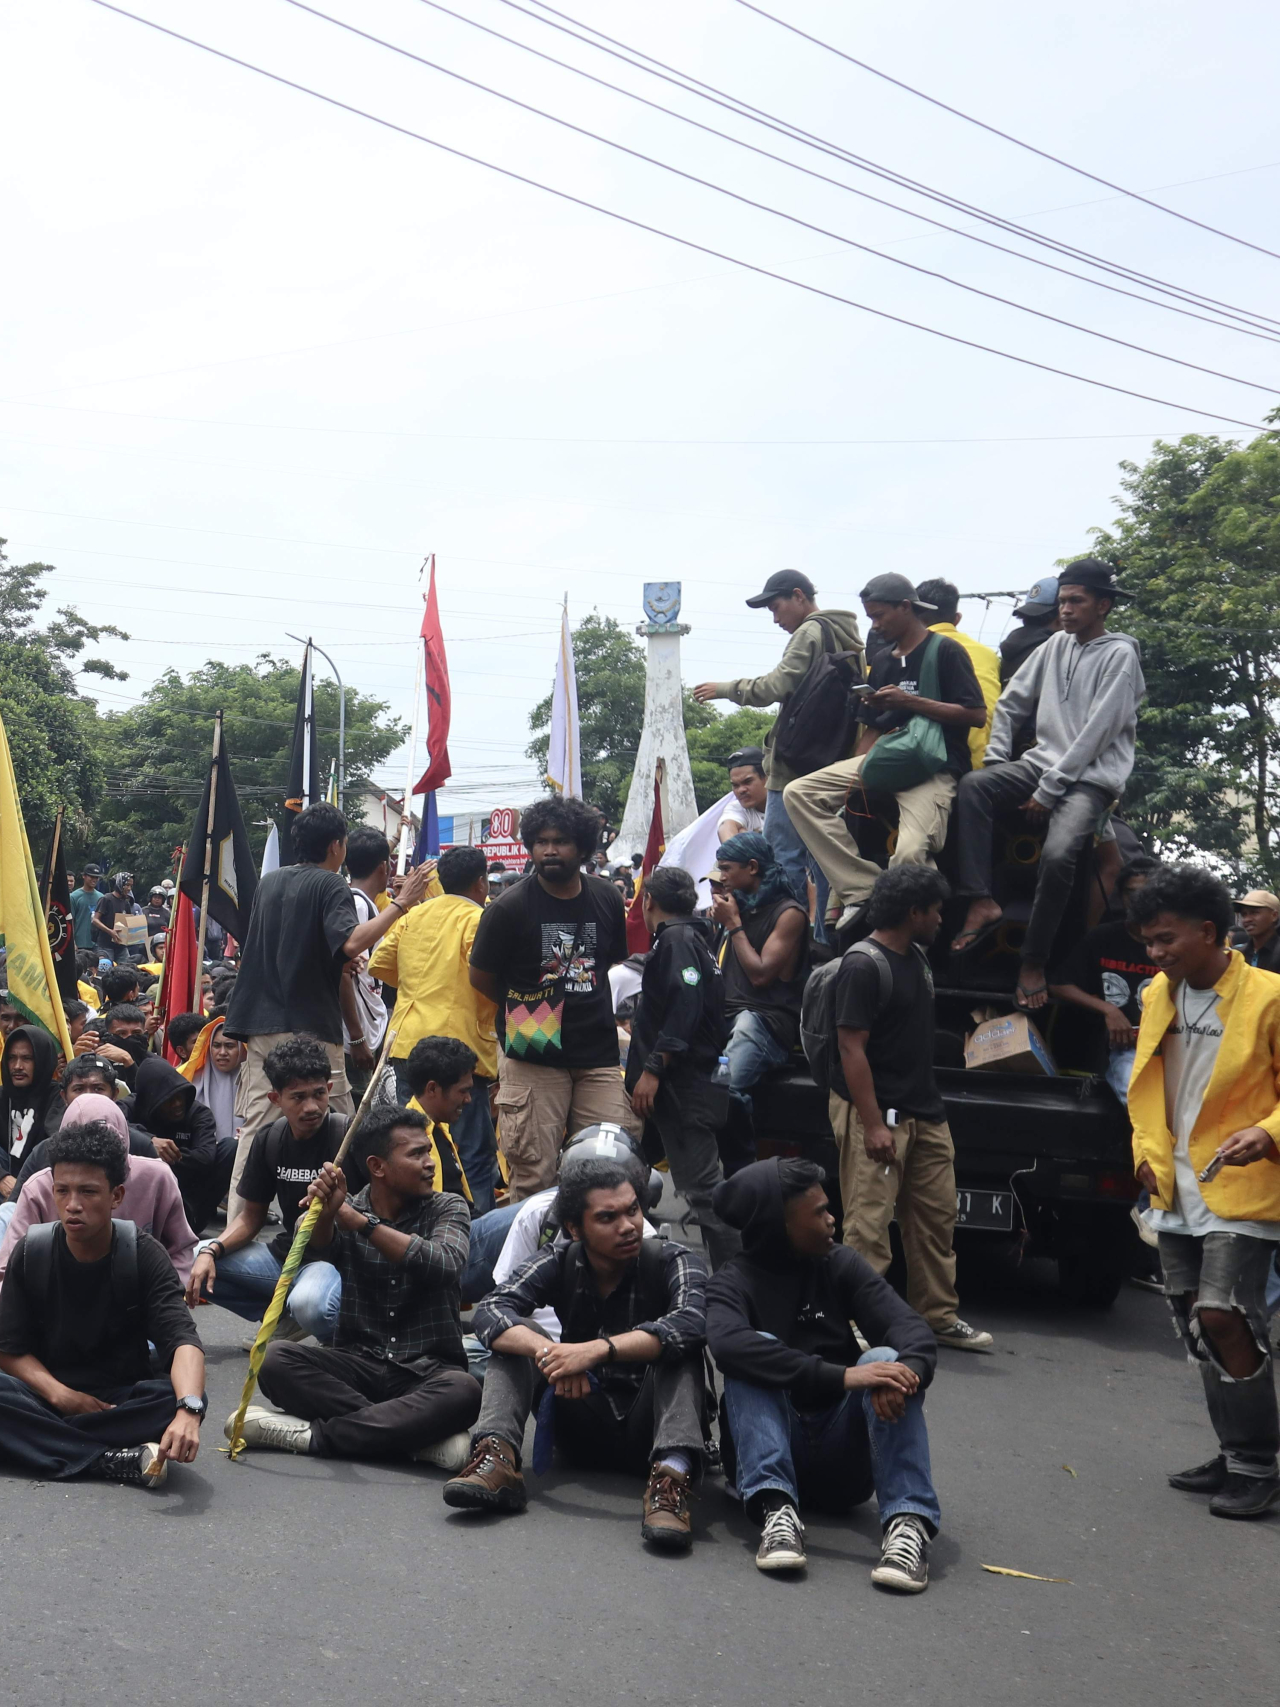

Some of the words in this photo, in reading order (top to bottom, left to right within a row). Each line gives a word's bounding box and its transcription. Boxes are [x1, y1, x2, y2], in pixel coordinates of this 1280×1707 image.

[490, 808, 513, 838] 80
[484, 844, 519, 857] REPUBLIK
[507, 987, 554, 1002] SALAWATI
[992, 1195, 1002, 1215] K
